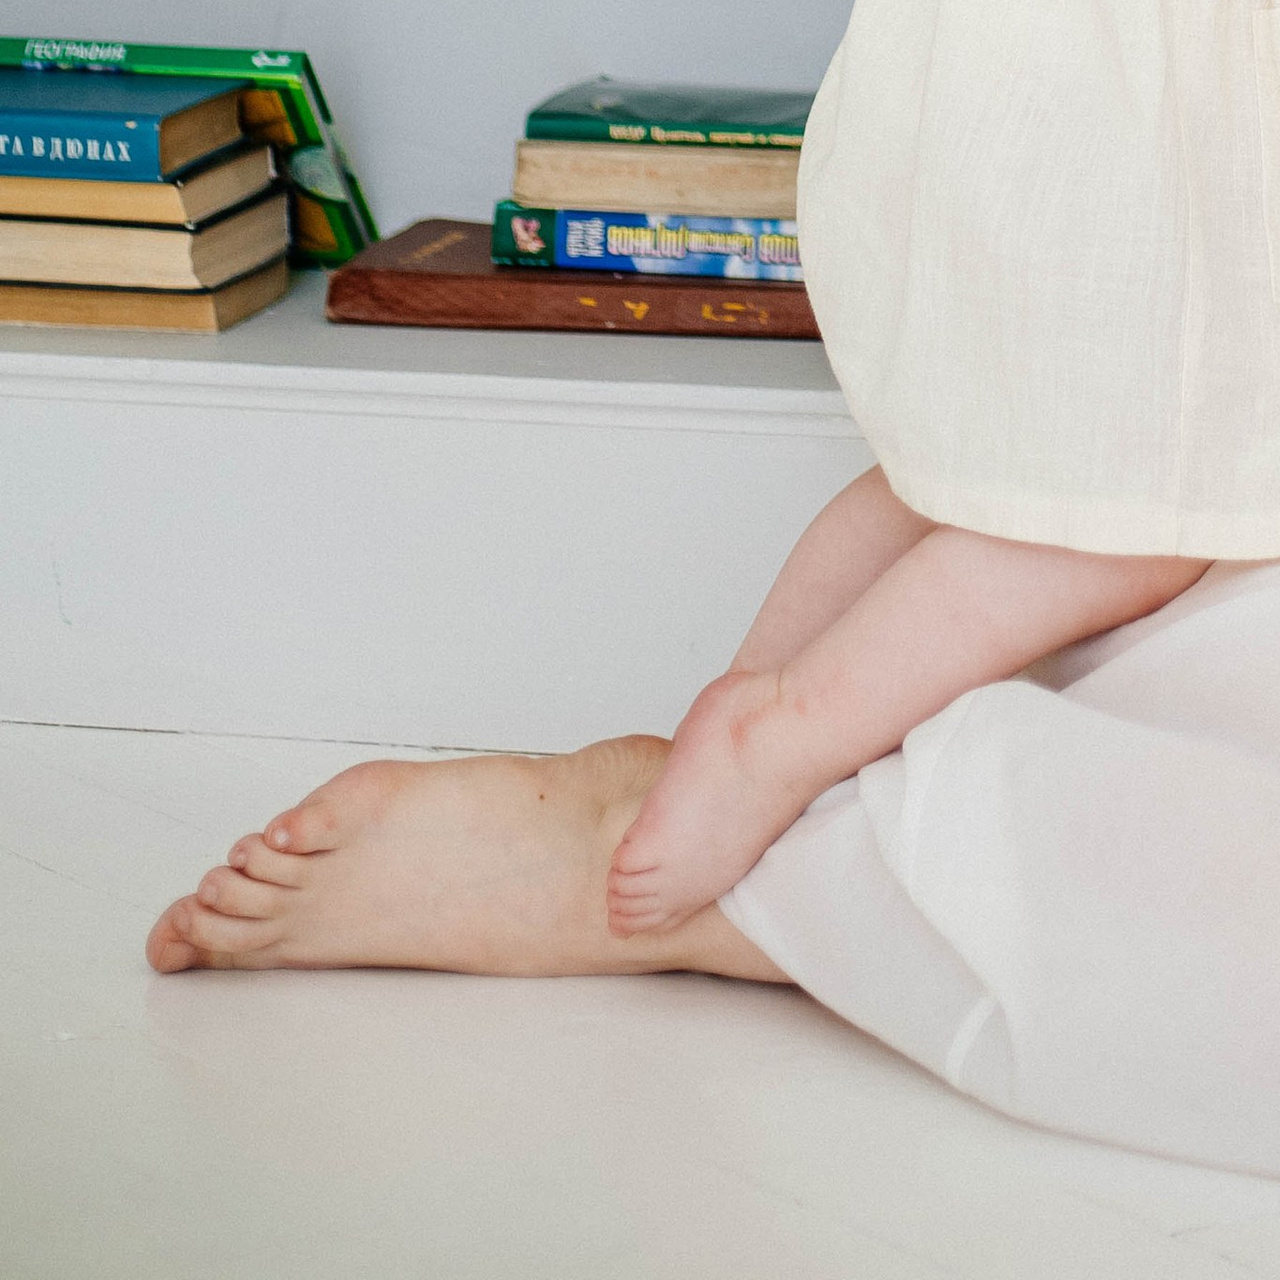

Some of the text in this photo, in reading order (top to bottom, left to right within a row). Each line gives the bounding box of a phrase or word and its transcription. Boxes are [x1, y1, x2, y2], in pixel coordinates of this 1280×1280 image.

[24, 39, 127, 61] ГЕОГРАФИЯ
[32, 136, 45, 157] В
[50, 137, 131, 162] ДЮНАХ
